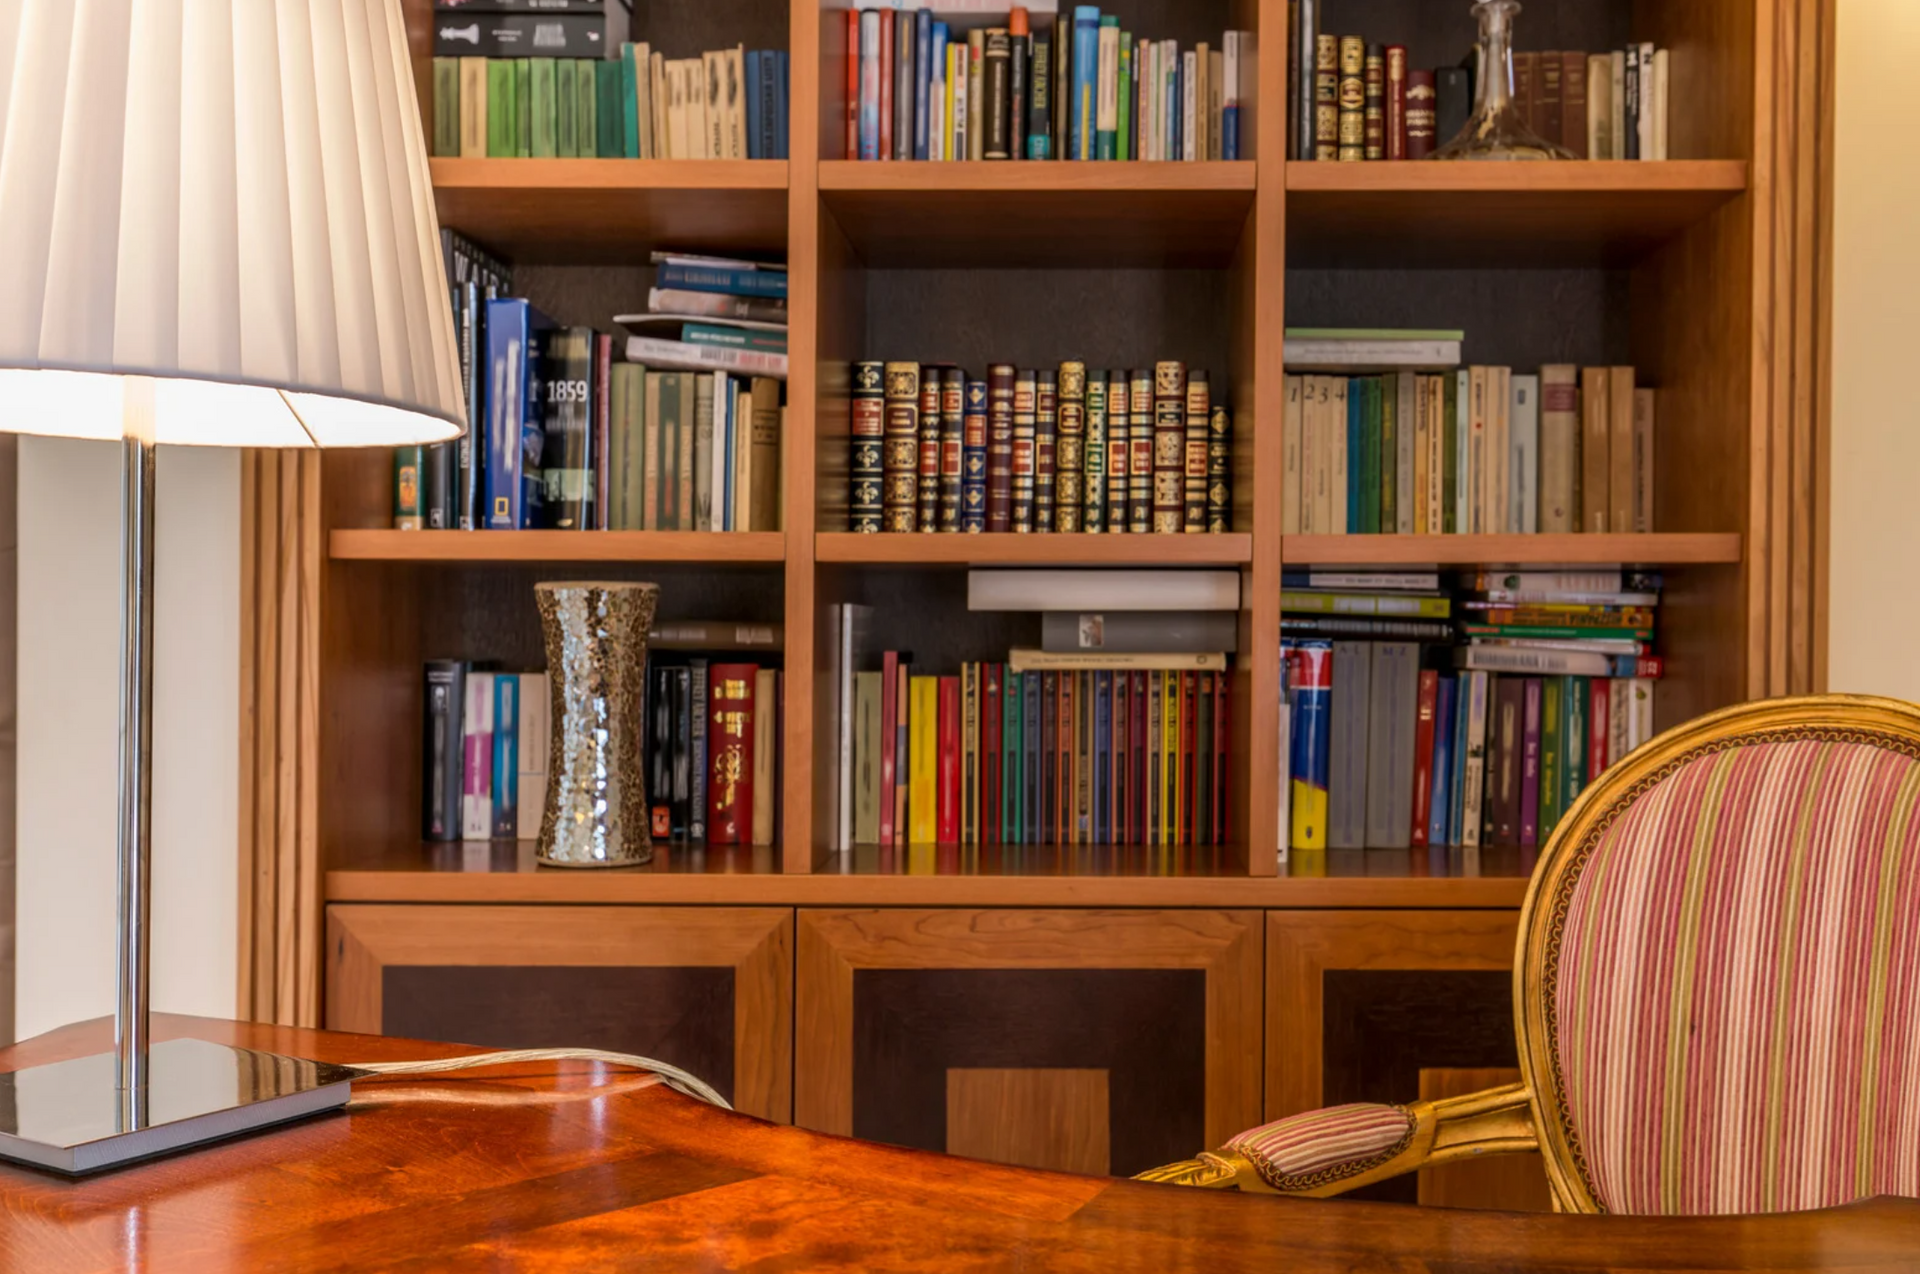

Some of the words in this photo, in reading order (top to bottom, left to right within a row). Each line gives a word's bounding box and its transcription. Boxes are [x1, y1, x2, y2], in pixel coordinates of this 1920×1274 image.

[546, 380, 588, 402] 1859
[1290, 387, 1298, 403] 1
[1304, 383, 1316, 400] 2
[1317, 387, 1329, 404] 3
[1334, 382, 1346, 402] 4
